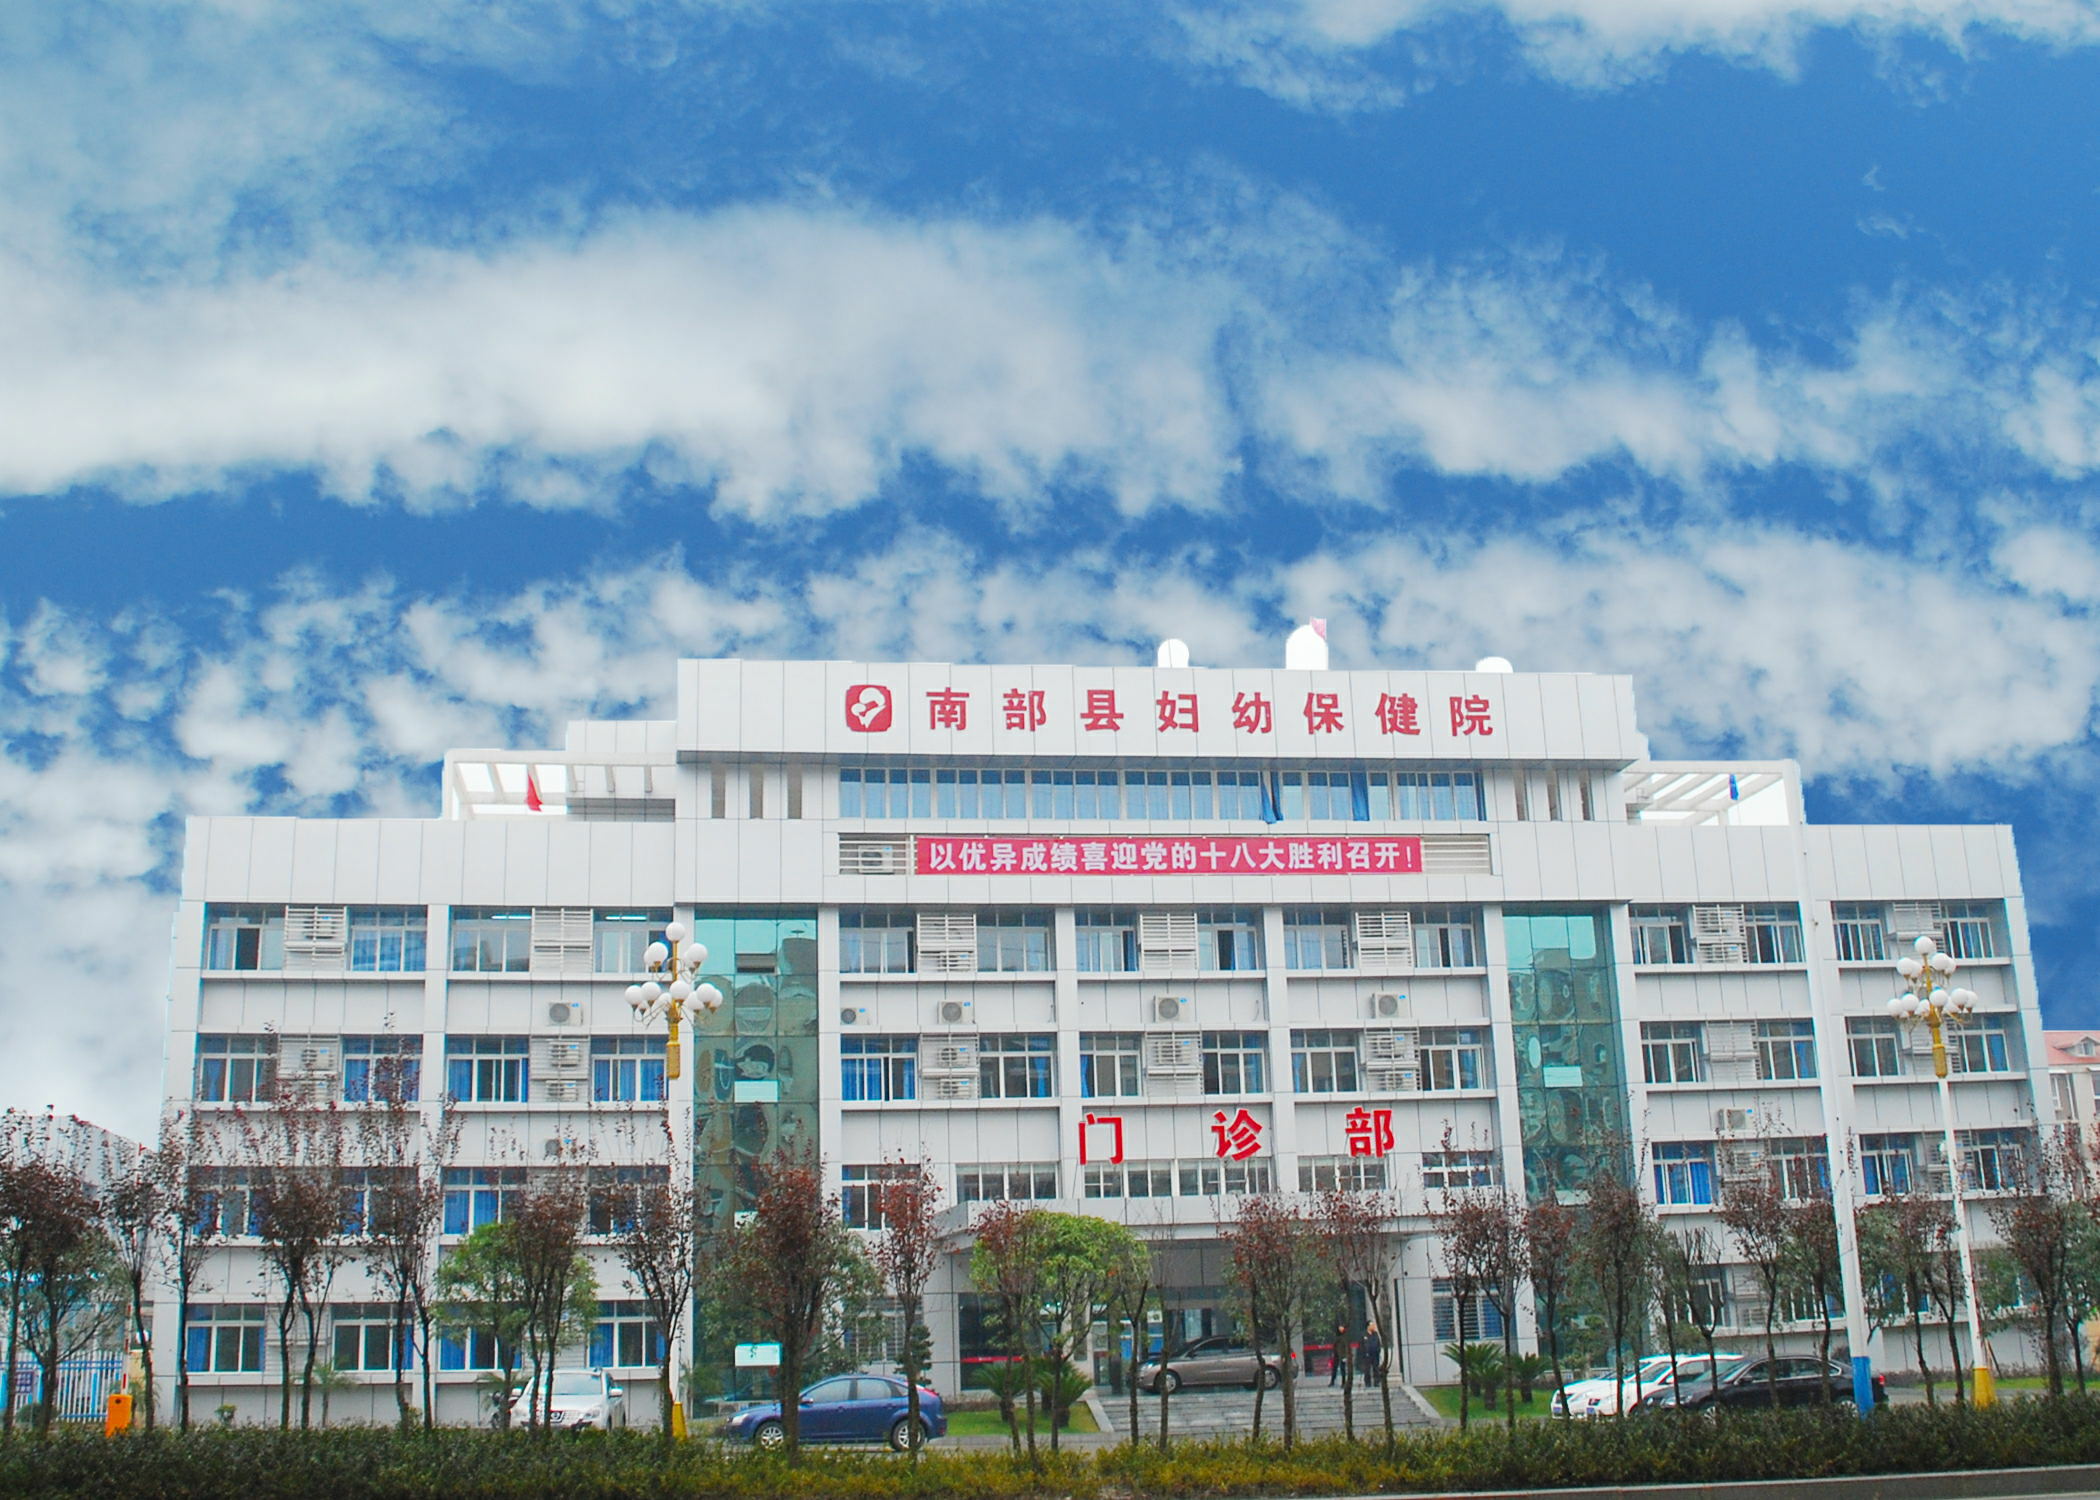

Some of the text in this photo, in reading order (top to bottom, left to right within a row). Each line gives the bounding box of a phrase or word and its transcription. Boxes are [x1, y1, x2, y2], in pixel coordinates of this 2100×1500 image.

[926, 686, 1494, 737] 南部县妇幼保健院
[1077, 1106, 1396, 1166] 门诊部
